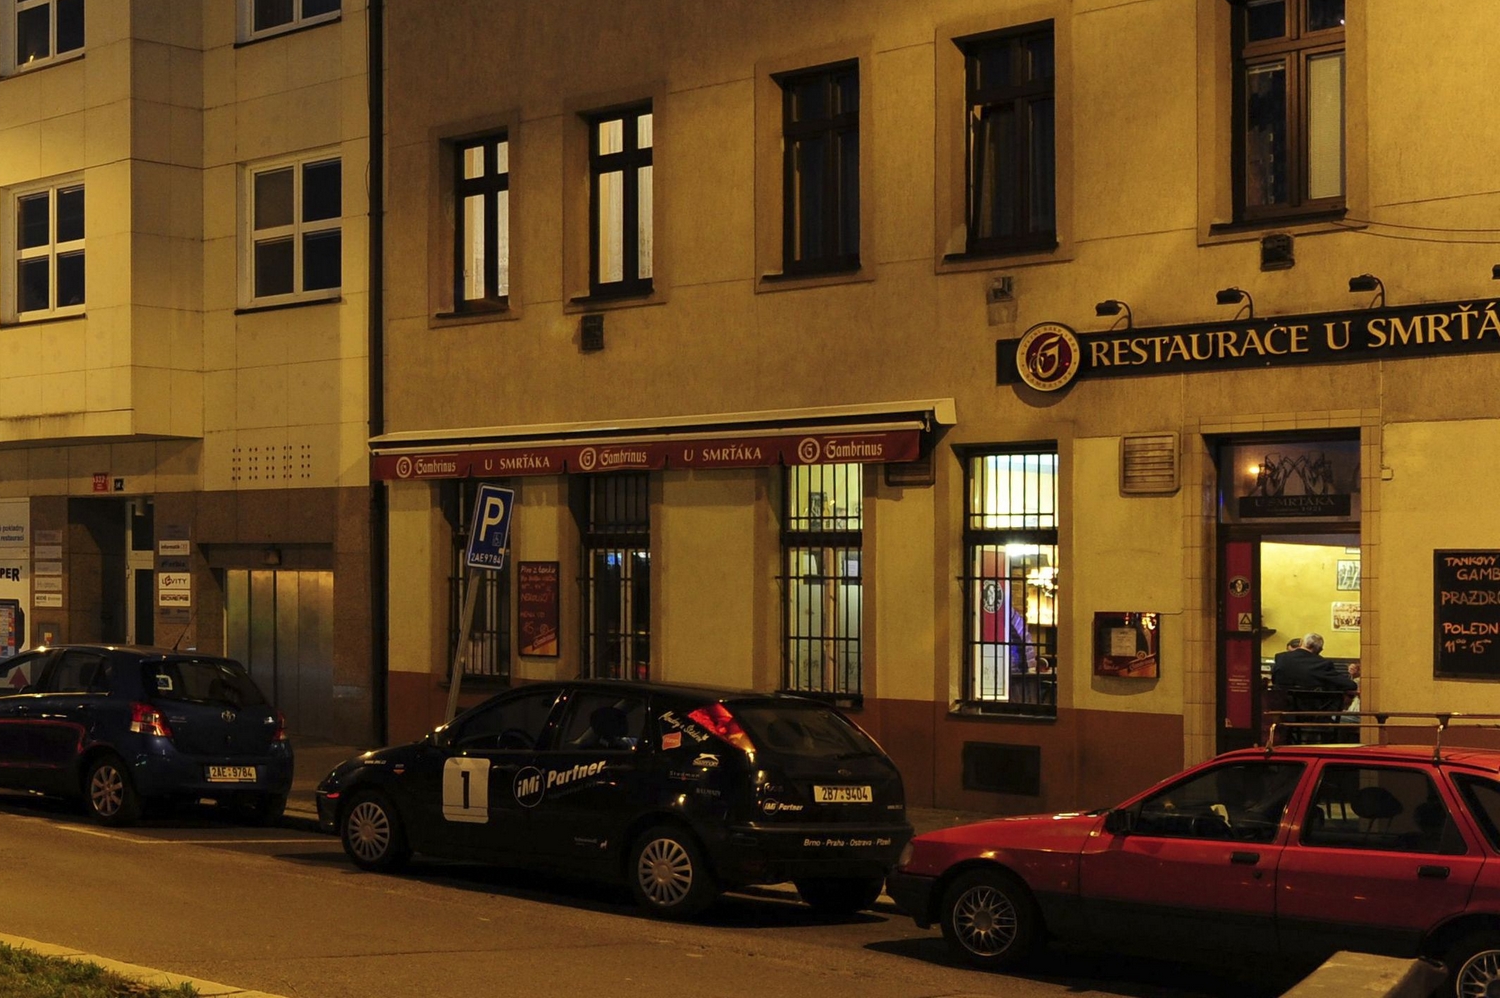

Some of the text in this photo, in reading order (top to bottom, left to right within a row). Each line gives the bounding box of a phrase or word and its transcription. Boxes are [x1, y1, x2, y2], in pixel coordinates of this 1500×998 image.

[1089, 324, 1310, 368] RESTAURACE
[1325, 321, 1354, 351] U
[600, 449, 647, 466] Gambrinus
[684, 444, 762, 462] U SMRŤÁKA
[826, 439, 883, 459] Gambrinus
[415, 459, 457, 475] Gambrinus
[484, 453, 550, 471] U SMRŤÁKA
[211, 766, 253, 778] 2AE 9784
[546, 760, 607, 789] Partner
[461, 771, 470, 809] 1
[822, 786, 868, 801] 2B7 9404
[803, 839, 821, 847] Brno
[825, 839, 845, 847] Praha
[849, 838, 872, 846] Ostrava
